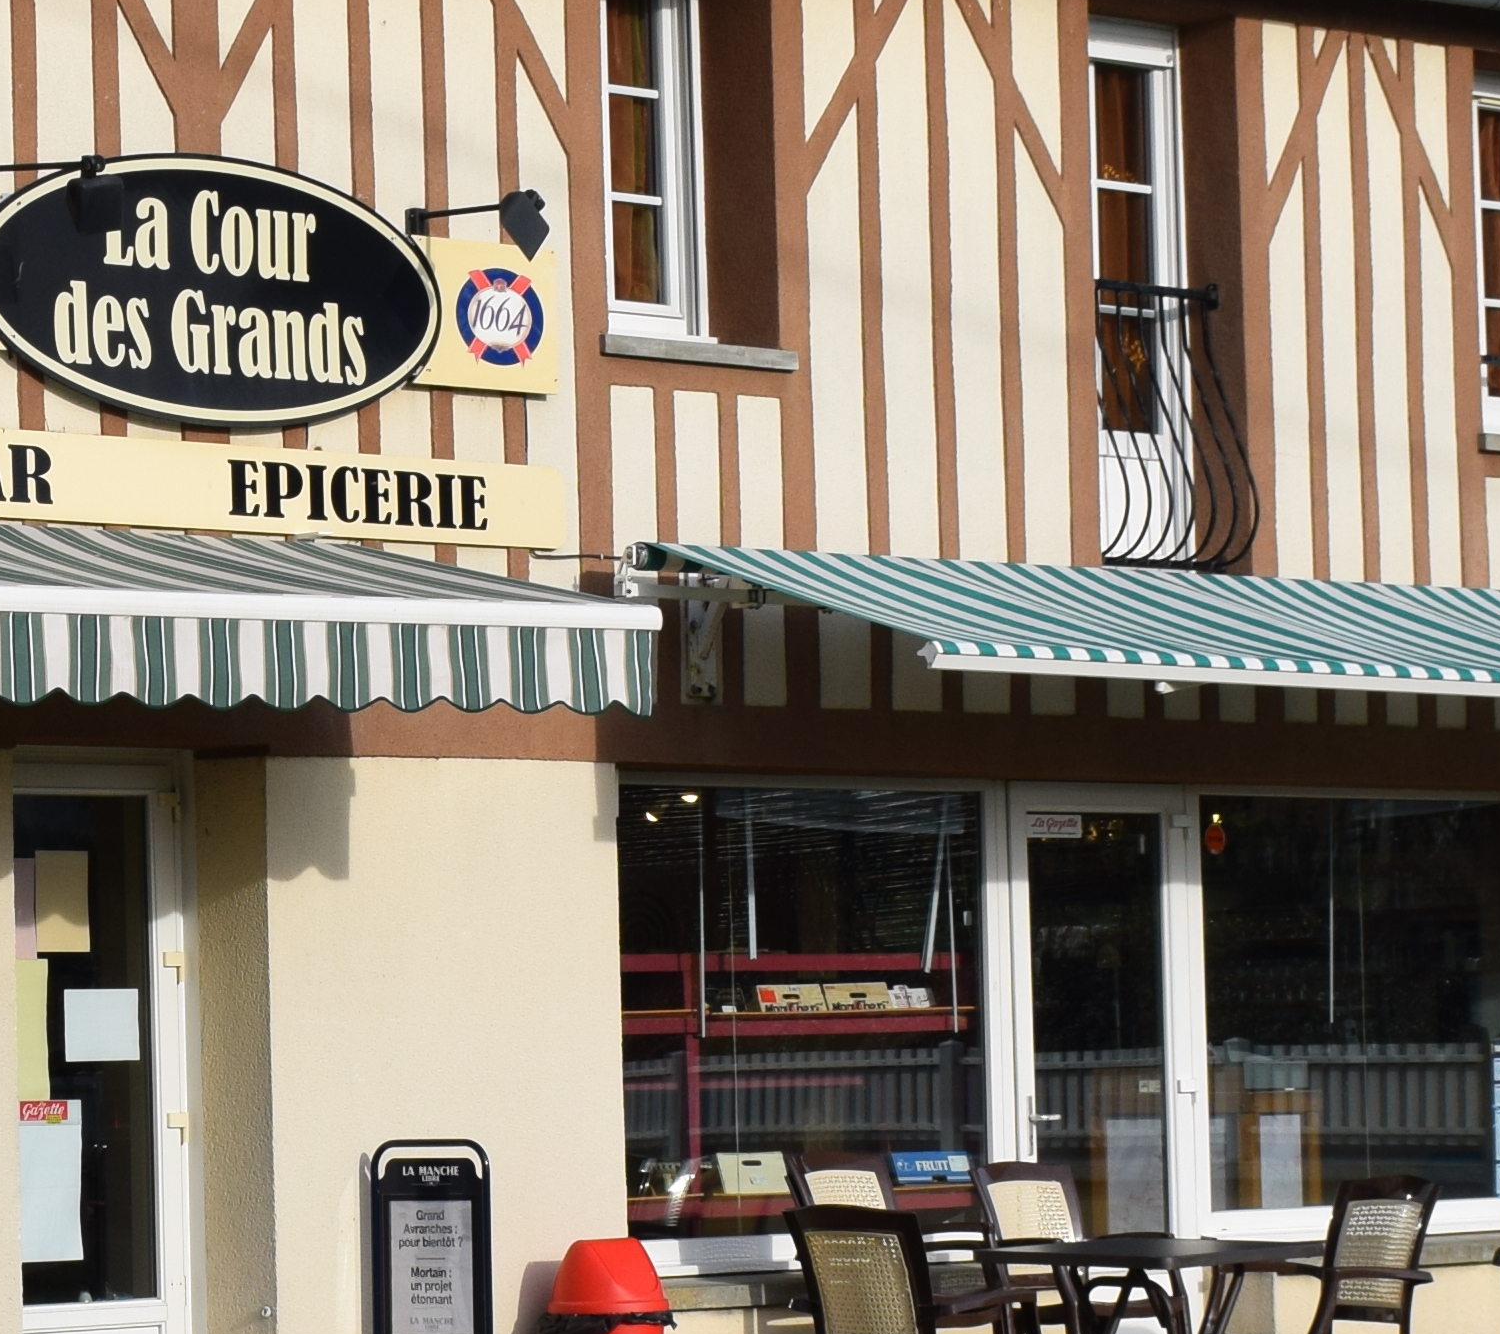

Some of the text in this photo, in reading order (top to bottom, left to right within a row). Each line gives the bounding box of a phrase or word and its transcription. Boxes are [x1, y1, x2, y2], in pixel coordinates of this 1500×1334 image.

[191, 190, 316, 282] Cour
[472, 295, 528, 336] 1664
[54, 280, 366, 386] des Grands
[228, 458, 489, 531] EPICERIE
[22, 1102, 65, 1121] Gazette
[402, 1166, 459, 1176] LA MANCHE
[915, 1160, 949, 1171] FRUIT
[416, 1209, 444, 1220] Grand
[403, 1223, 453, 1234] Avranches
[399, 1238, 420, 1250] pour
[423, 1236, 455, 1247] bientôt
[410, 1267, 447, 1278] Mortain
[410, 1280, 452, 1293] un projet
[411, 1293, 453, 1304] étonnant
